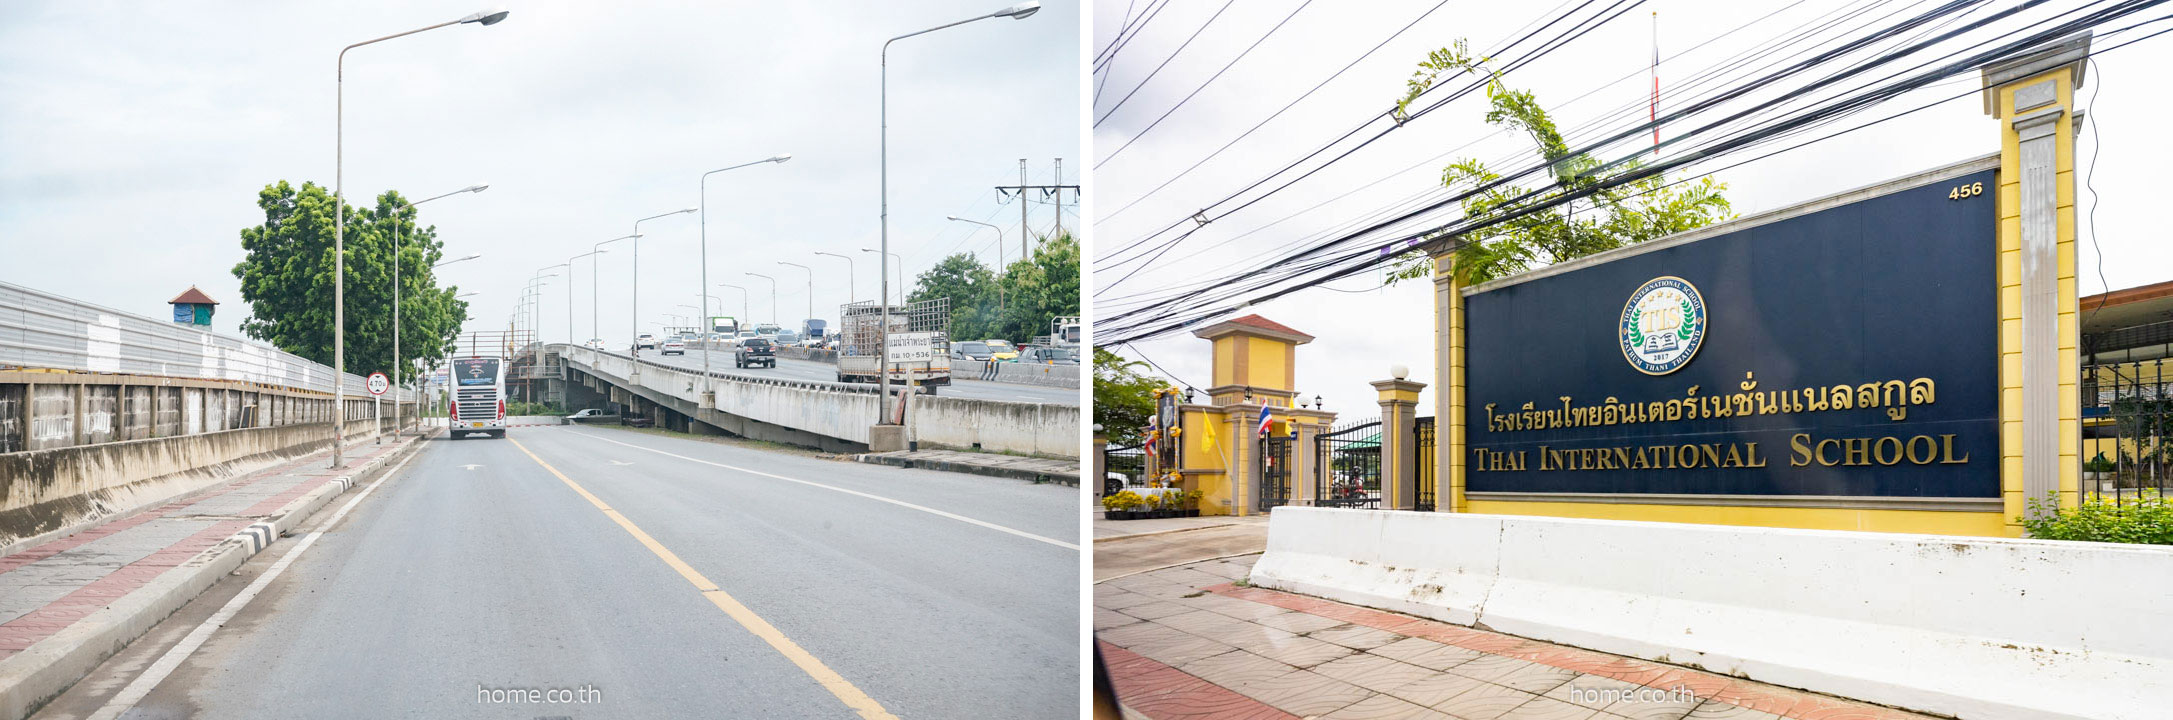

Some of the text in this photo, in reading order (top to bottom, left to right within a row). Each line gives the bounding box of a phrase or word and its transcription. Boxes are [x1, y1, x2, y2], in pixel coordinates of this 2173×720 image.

[1948, 181, 1983, 200] 456
[1623, 280, 1701, 322] THAI INTERNATIONAL SCHOOL
[1641, 305, 1681, 333] TIS
[888, 335, 931, 347] แม่น้ำเจ้าพระยา
[1623, 338, 1643, 366] PATHUM
[1645, 363, 1669, 371] THANI
[1672, 330, 1701, 367] THAILAND
[1653, 353, 1669, 361] 2017
[1484, 371, 1936, 433] โรงเรียนไทยอินเตอร์เนชั่นแนลสกูล
[1473, 432, 1970, 472] THAI INTERNATIONAL SCHOOL
